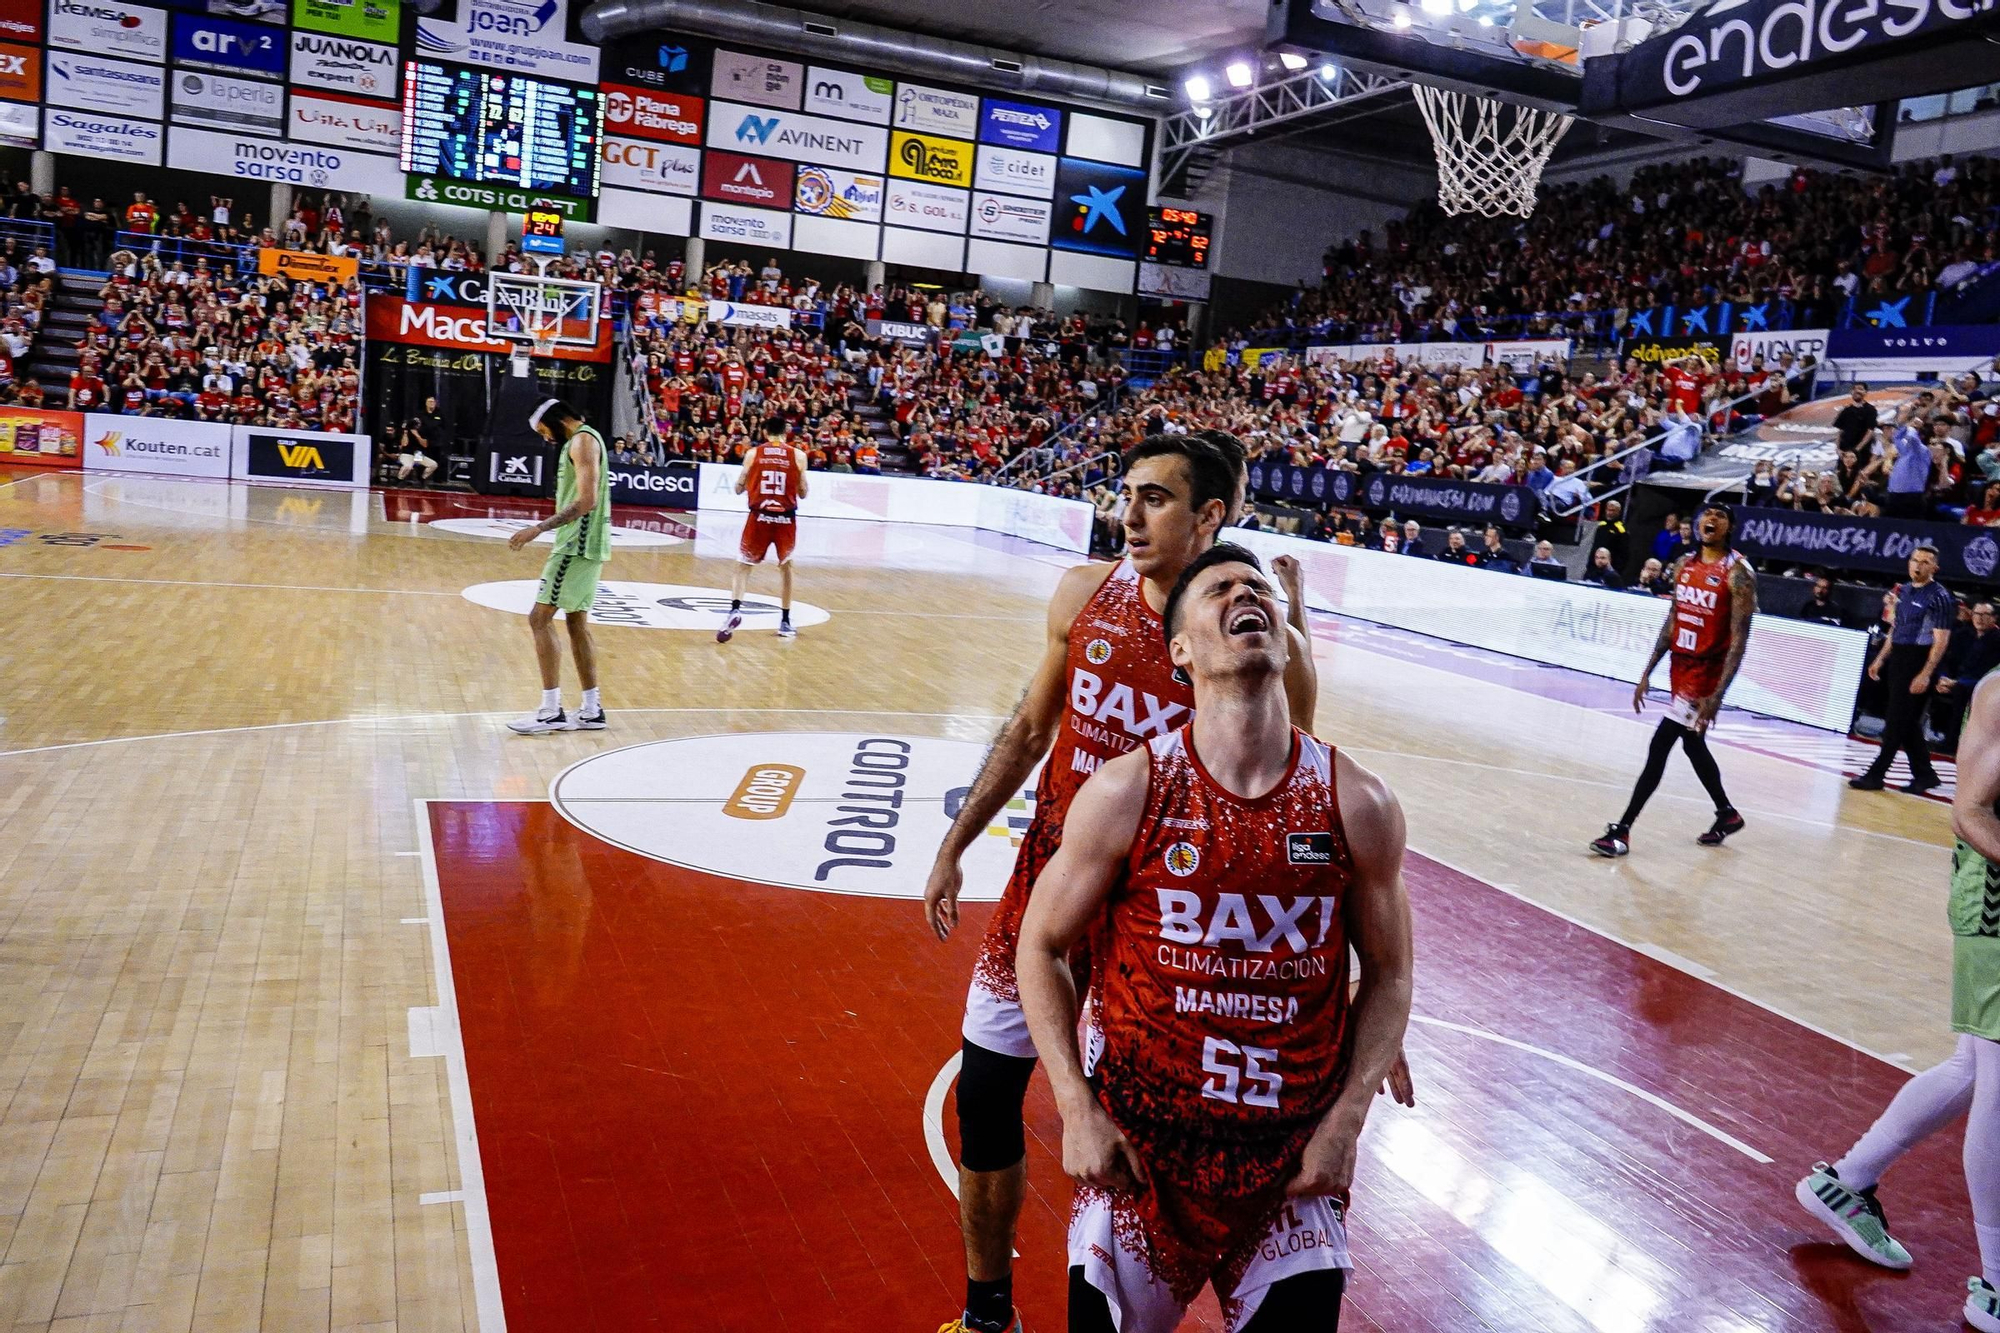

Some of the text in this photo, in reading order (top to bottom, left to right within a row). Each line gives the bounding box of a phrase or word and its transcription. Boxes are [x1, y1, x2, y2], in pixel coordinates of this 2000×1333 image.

[467, 10, 529, 37] joan
[295, 37, 394, 66] JUANOLA
[74, 65, 161, 86] santasusana
[307, 70, 354, 83] expert
[625, 67, 666, 82] CUBE
[634, 95, 681, 116] Plana
[52, 114, 158, 139] Sagalés
[778, 129, 863, 155] AVINENT
[235, 143, 341, 170] movento
[602, 142, 659, 169] GCT
[235, 160, 303, 182] sarsa
[1008, 160, 1045, 177] cidet
[444, 186, 496, 205] COTS
[499, 193, 505, 206] i
[711, 214, 766, 229] movento
[923, 205, 948, 217] GOL
[533, 222, 556, 236] 24
[711, 224, 746, 236] sarsa
[736, 309, 778, 323] masats
[881, 322, 927, 341] KIBUC
[1883, 336, 1948, 348] VOLVO
[126, 439, 221, 457] Kouten.cat
[760, 470, 787, 495] 29
[1676, 584, 1718, 609] BAXI
[737, 768, 794, 814] GROUP
[814, 738, 912, 881] CONTROL
[1155, 887, 1336, 954] BAXI
[1175, 986, 1299, 1024] MANRESA
[1201, 1036, 1283, 1109] 55
[1260, 1228, 1334, 1261] GLOBAL
